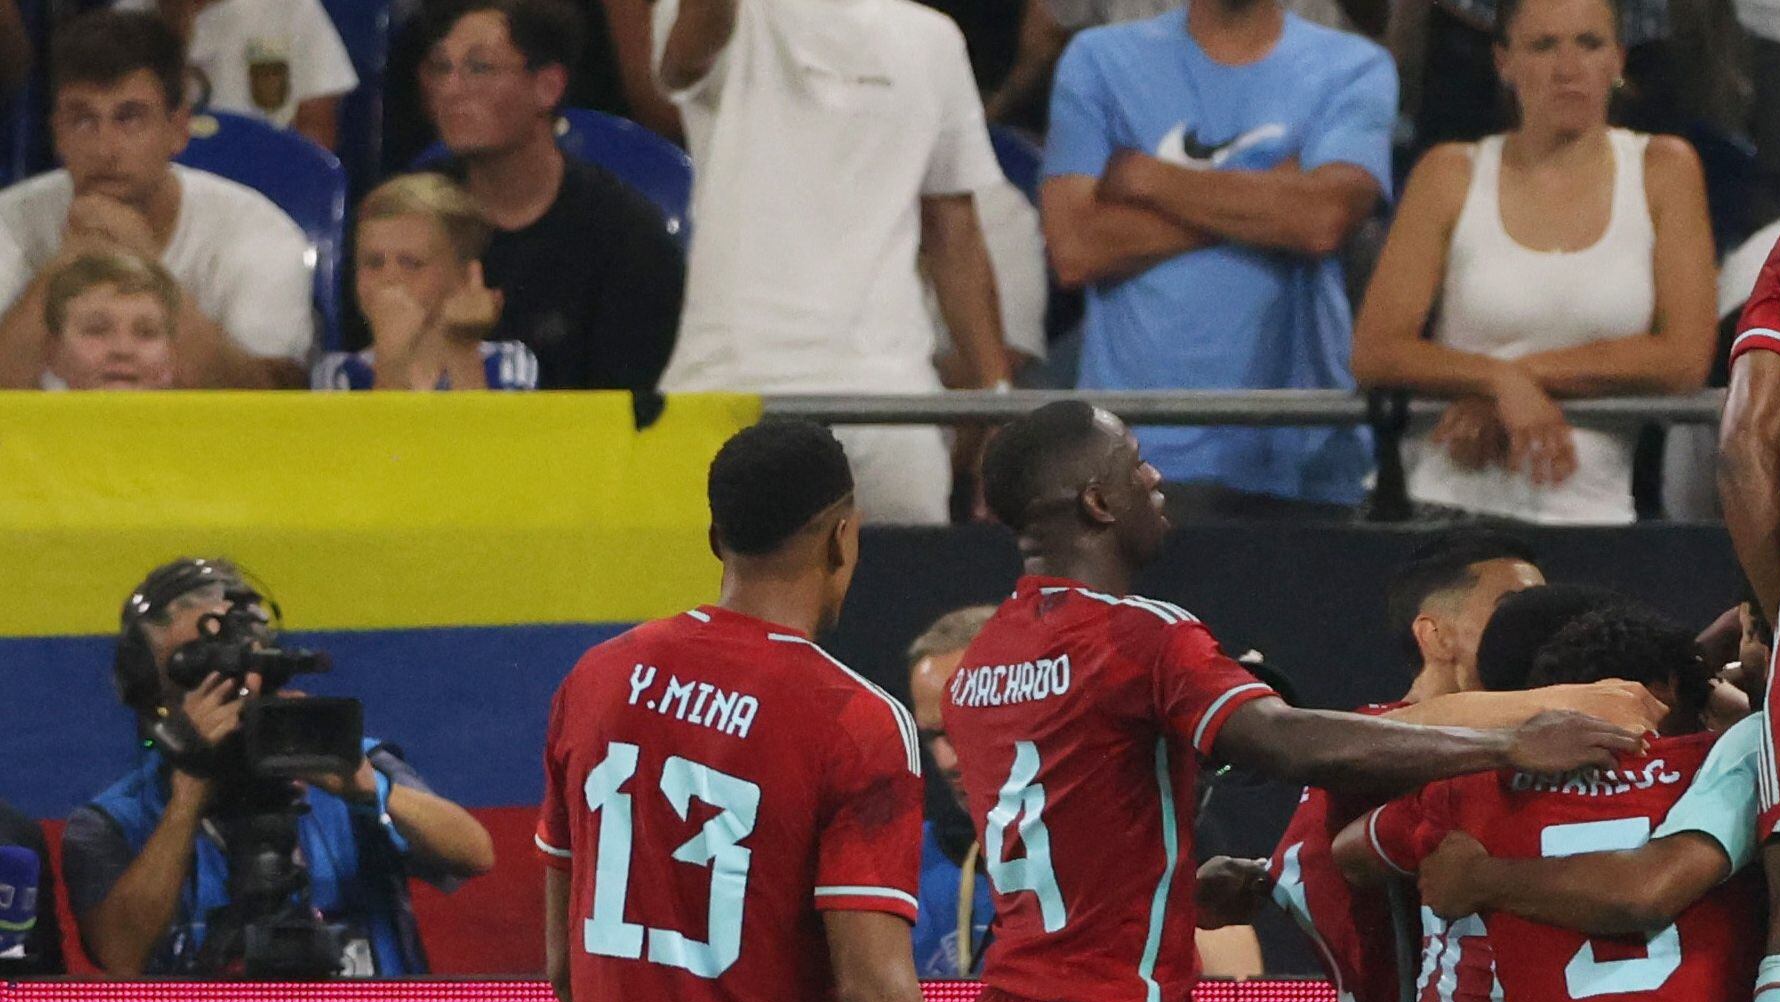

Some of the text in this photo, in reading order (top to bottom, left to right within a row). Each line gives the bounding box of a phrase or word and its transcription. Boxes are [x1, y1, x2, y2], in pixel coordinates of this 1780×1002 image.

[628, 663, 760, 739] Y.MINA
[583, 742, 761, 979] 13
[985, 741, 1067, 933] 4
